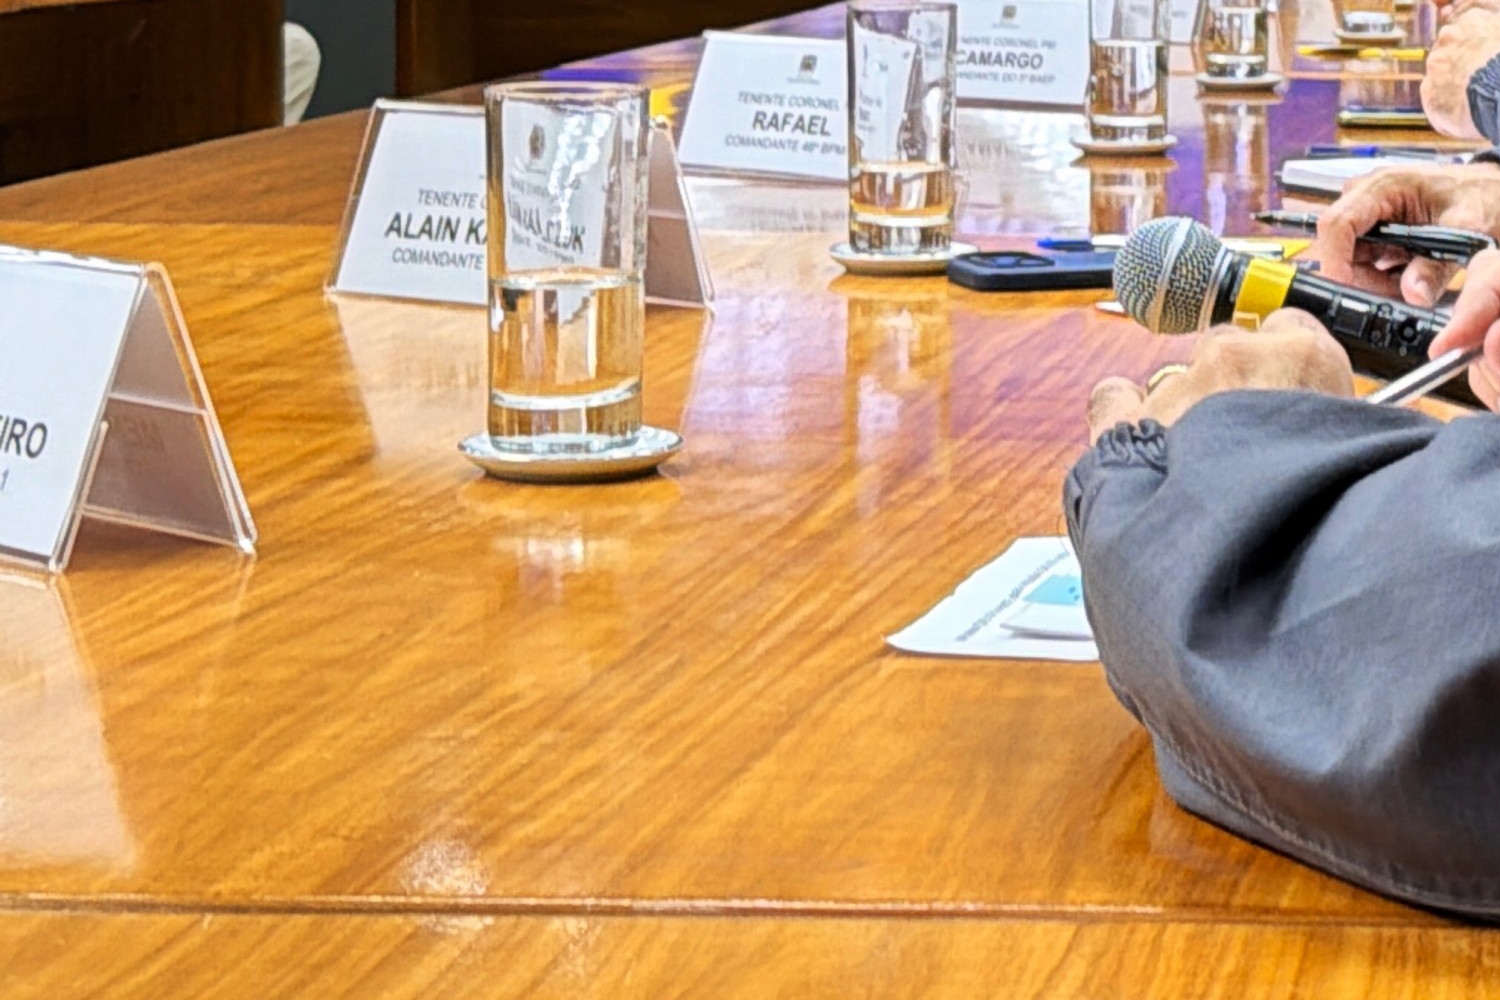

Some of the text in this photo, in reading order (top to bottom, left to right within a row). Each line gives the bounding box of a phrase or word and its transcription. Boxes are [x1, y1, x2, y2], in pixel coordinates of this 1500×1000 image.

[956, 48, 1044, 70] CAMARGO
[738, 90, 786, 107] TENENTE
[788, 94, 840, 112] CORONEL
[752, 111, 831, 137] RAFAEL
[725, 133, 800, 153] COMANDANTE
[417, 188, 479, 209] TENENTE
[384, 210, 462, 243] ALAIN
[392, 246, 485, 270] COMANDANTE
[0, 413, 48, 459] IRO
